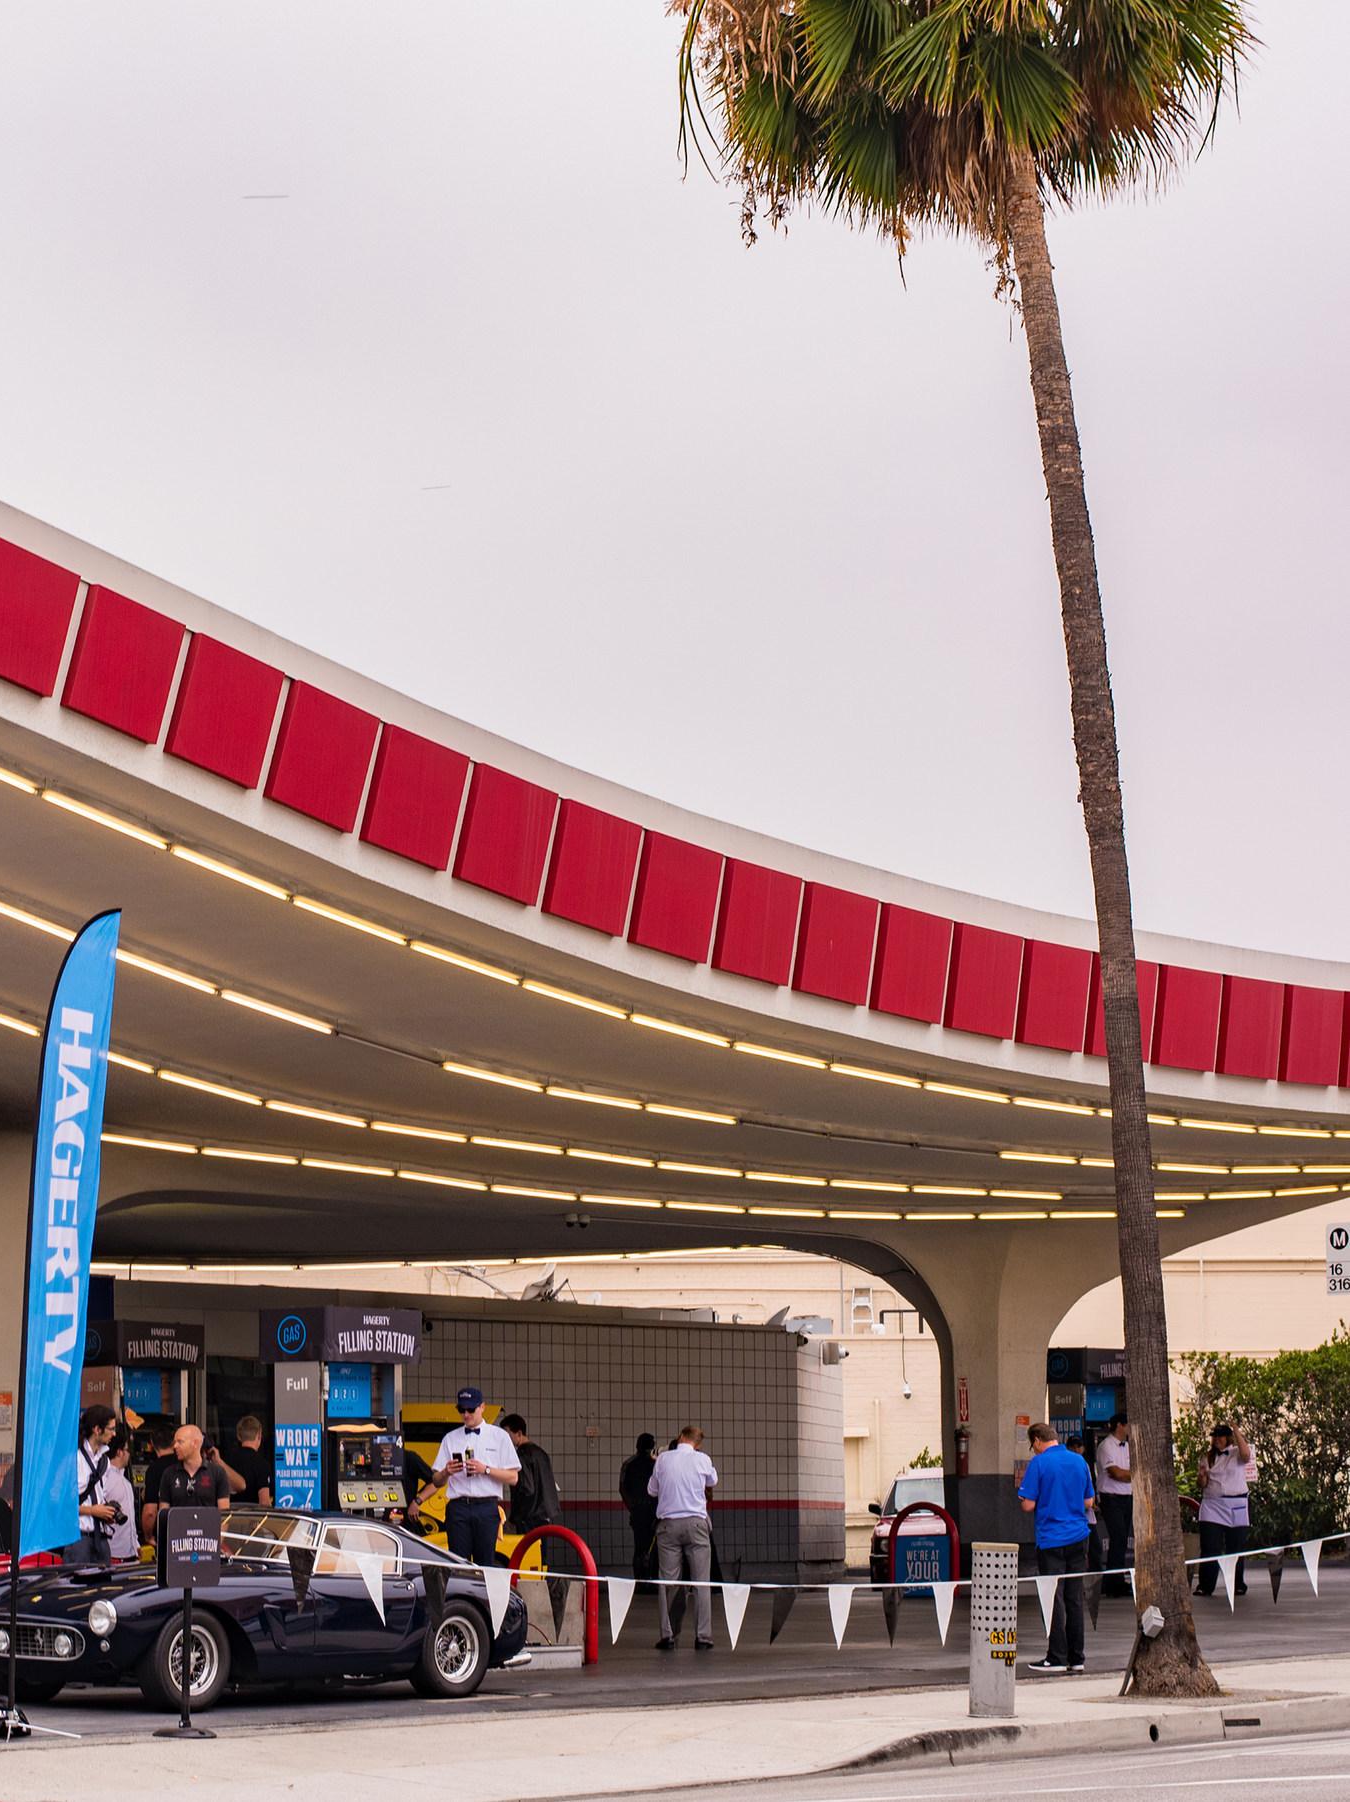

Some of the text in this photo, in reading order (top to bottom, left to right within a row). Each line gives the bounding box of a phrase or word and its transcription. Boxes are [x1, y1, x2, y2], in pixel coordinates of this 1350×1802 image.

[43, 1007, 94, 1374] HAGERTY
[1329, 1263, 1343, 1276] 16
[1329, 1278, 1350, 1291] 316
[363, 1315, 391, 1326] HAGERTY
[150, 1327, 177, 1337] HAGERTY
[283, 1324, 301, 1344] GAS
[86, 1335, 97, 1350] AS
[338, 1330, 415, 1357] FILLING STATION
[127, 1340, 199, 1363] FILLING STATION
[1100, 1363, 1123, 1379] FILLING
[87, 1381, 106, 1392] Self
[286, 1377, 309, 1391] Full
[1054, 1395, 1072, 1405] Self
[275, 1428, 318, 1447] WRONG
[395, 1435, 403, 1449] 4
[285, 1448, 310, 1466] WAY
[276, 1469, 290, 1478] PLEASE
[291, 1469, 304, 1478] ENTER
[171, 1537, 218, 1553] FILLING STATION
[906, 1550, 940, 1561] WE'RE AT
[906, 1561, 940, 1580] YOUR
[990, 1632, 1005, 1644] GS
